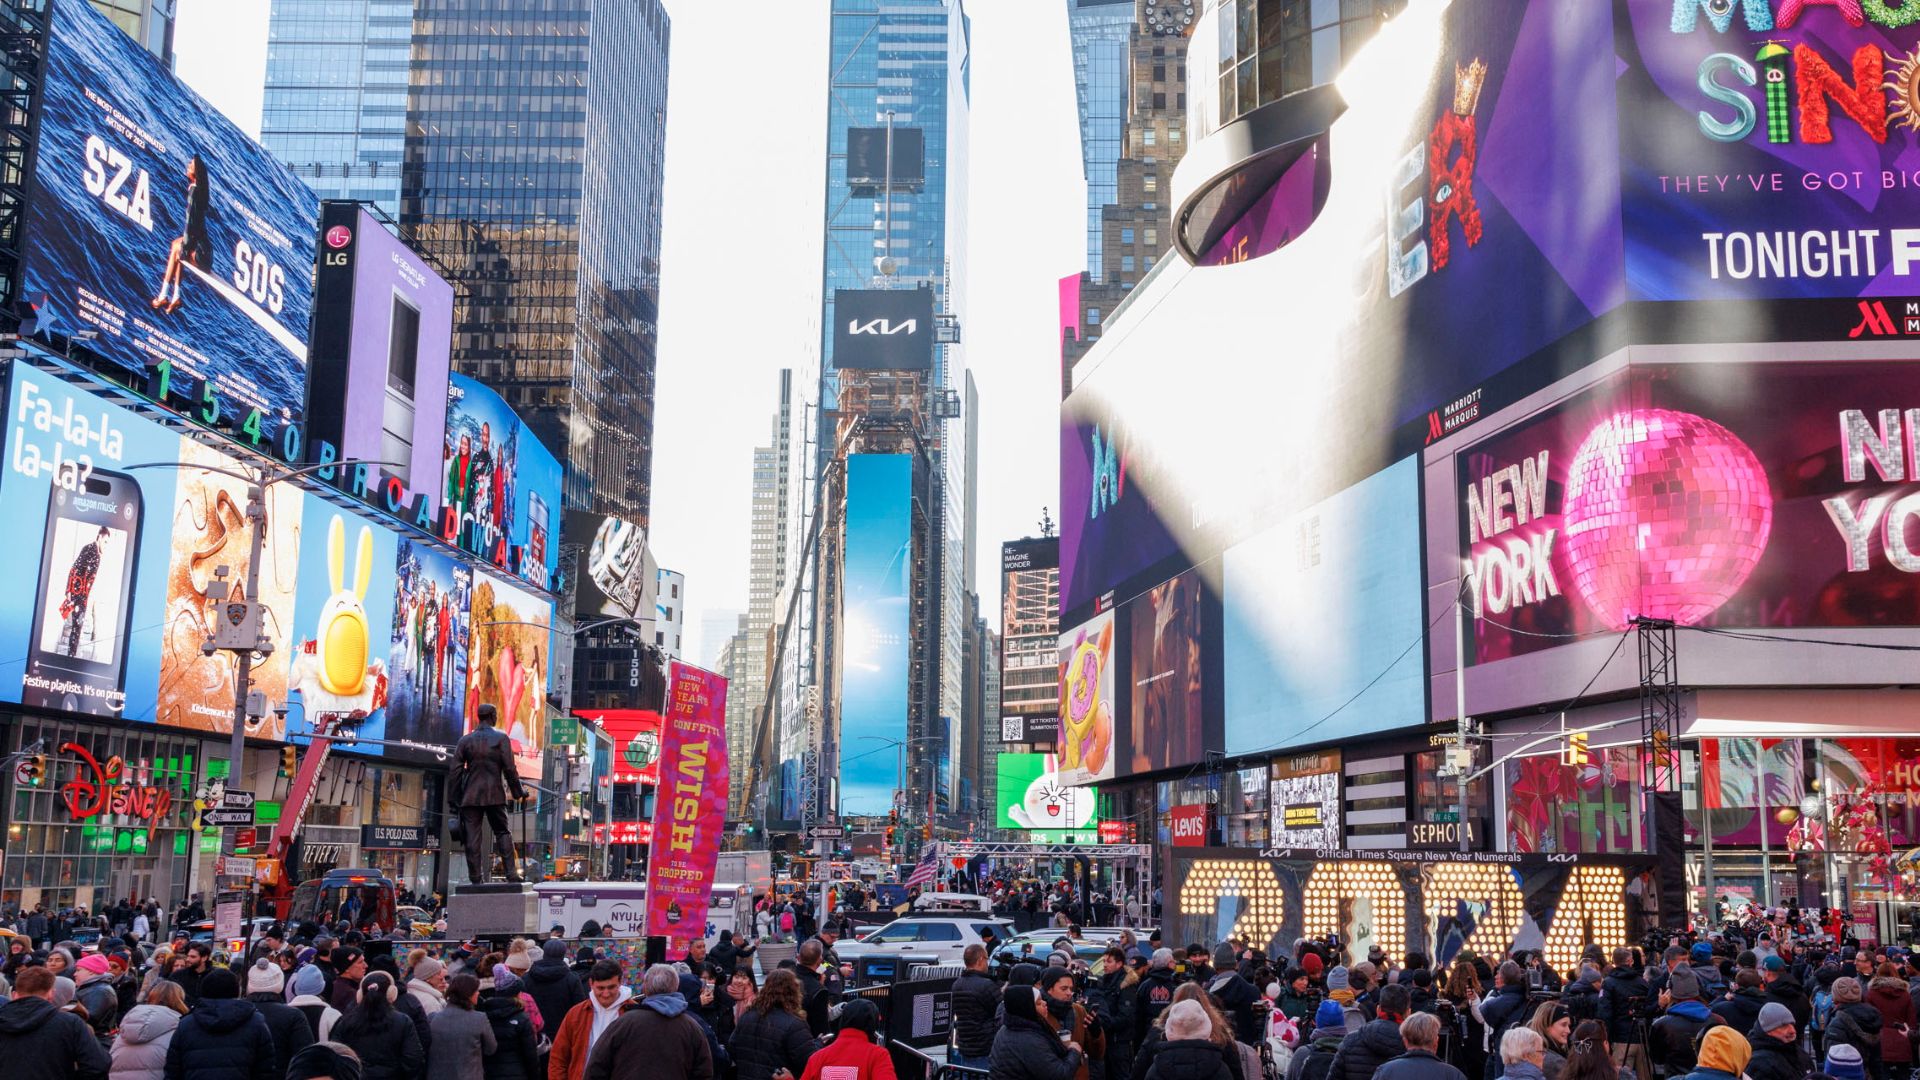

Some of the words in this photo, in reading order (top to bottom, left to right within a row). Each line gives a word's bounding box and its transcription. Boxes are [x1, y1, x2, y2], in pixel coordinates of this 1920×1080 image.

[84, 134, 153, 232] SZA
[1659, 172, 1784, 193] THEY'VE
[1802, 171, 1864, 191] GOT
[326, 252, 348, 266] LG
[1702, 230, 1880, 279] TONIGHT
[234, 240, 284, 314] SOS
[849, 318, 917, 335] KIA
[1445, 389, 1482, 417] MARRIOTT
[18, 380, 124, 462] Fa-la-la
[1445, 406, 1480, 432] MARQUIS
[12, 426, 94, 496] la-la?
[73, 496, 97, 512] amazon
[97, 500, 118, 514] music
[1468, 450, 1549, 544] NEW
[1004, 554, 1029, 562] IMAGINE
[1004, 561, 1030, 569] WONDER
[1466, 528, 1562, 619] YORK
[630, 650, 639, 688] 1500
[22, 673, 50, 690] Festive
[50, 678, 83, 696] playlists.
[84, 682, 96, 698] It's
[96, 688, 106, 698] on
[106, 688, 126, 702] prime
[678, 680, 700, 693] NEW
[675, 702, 694, 714] EVE
[673, 719, 720, 737] CONFETTI
[670, 738, 710, 854] WISH
[231, 813, 248, 821] WAY
[386, 828, 402, 840] POLO
[1412, 822, 1474, 844] SEPHOA
[1260, 850, 1291, 858] KIA
[1316, 849, 1355, 859] Official
[1356, 850, 1385, 860] Times
[1386, 850, 1422, 862] Square
[1425, 852, 1448, 861] New
[1449, 852, 1472, 862] Year
[1474, 852, 1522, 862] Numerals
[1547, 854, 1578, 862] KIA
[658, 866, 704, 880] DROPPED
[612, 912, 632, 922] NYU
[933, 1008, 950, 1019] SQUARE
[936, 1001, 949, 1009] TIMES
